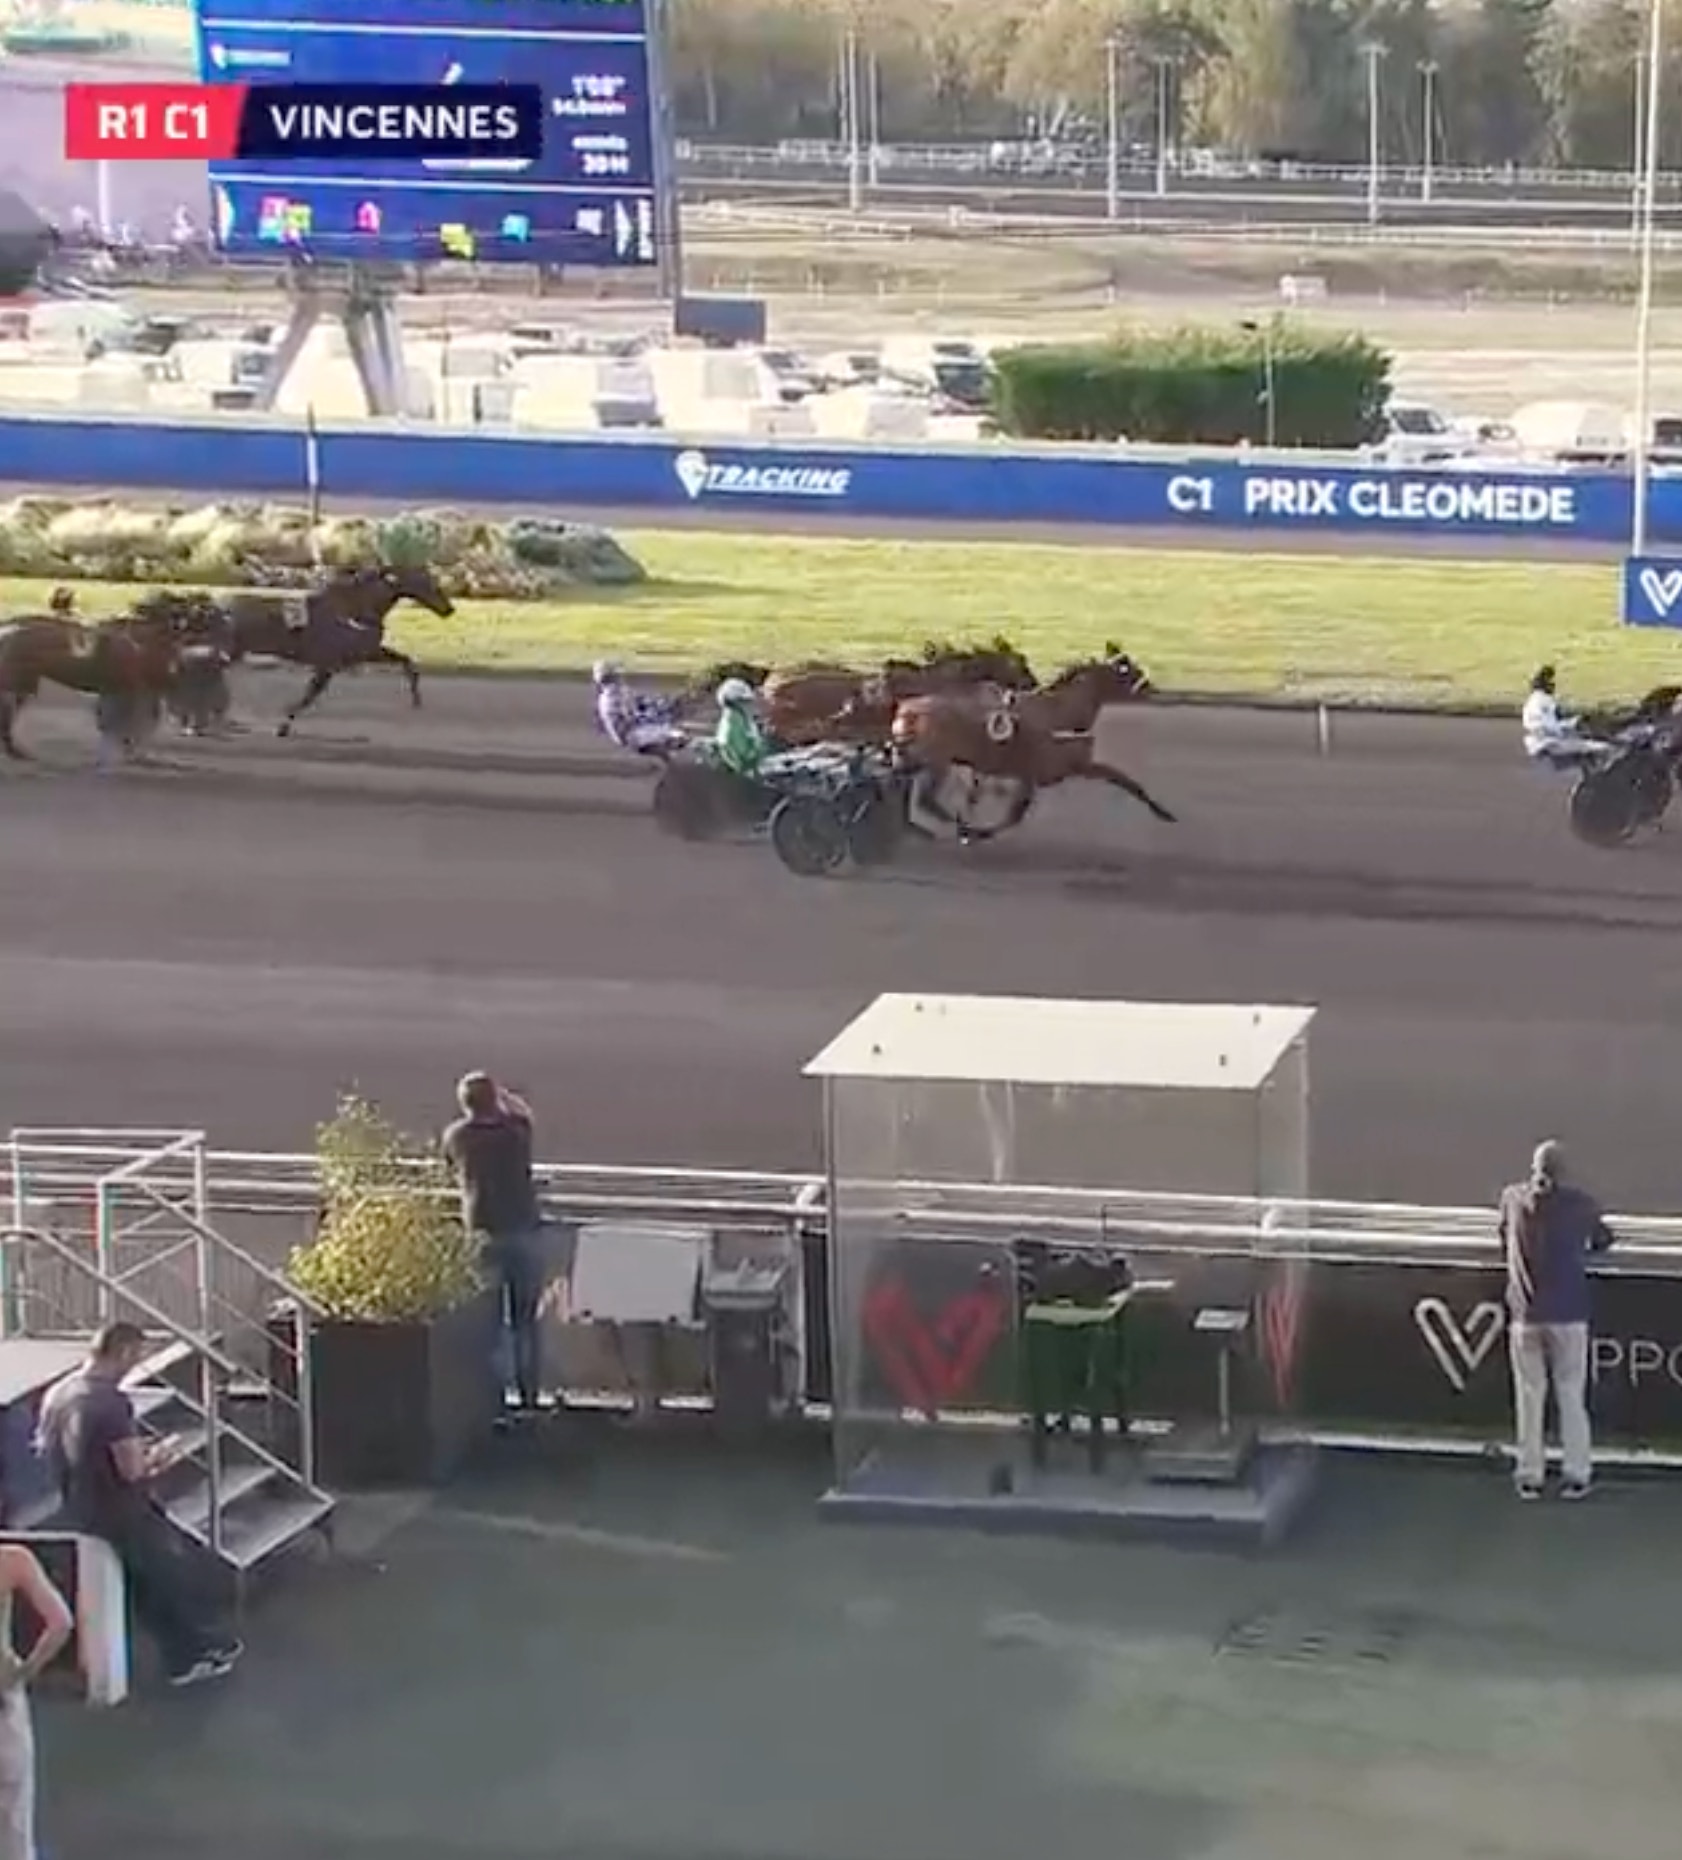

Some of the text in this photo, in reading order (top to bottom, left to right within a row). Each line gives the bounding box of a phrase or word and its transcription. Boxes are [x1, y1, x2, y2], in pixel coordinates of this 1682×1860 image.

[708, 464, 851, 494] TRACKING
[1166, 476, 1576, 522] C1 PRIX CLEOMEDE
